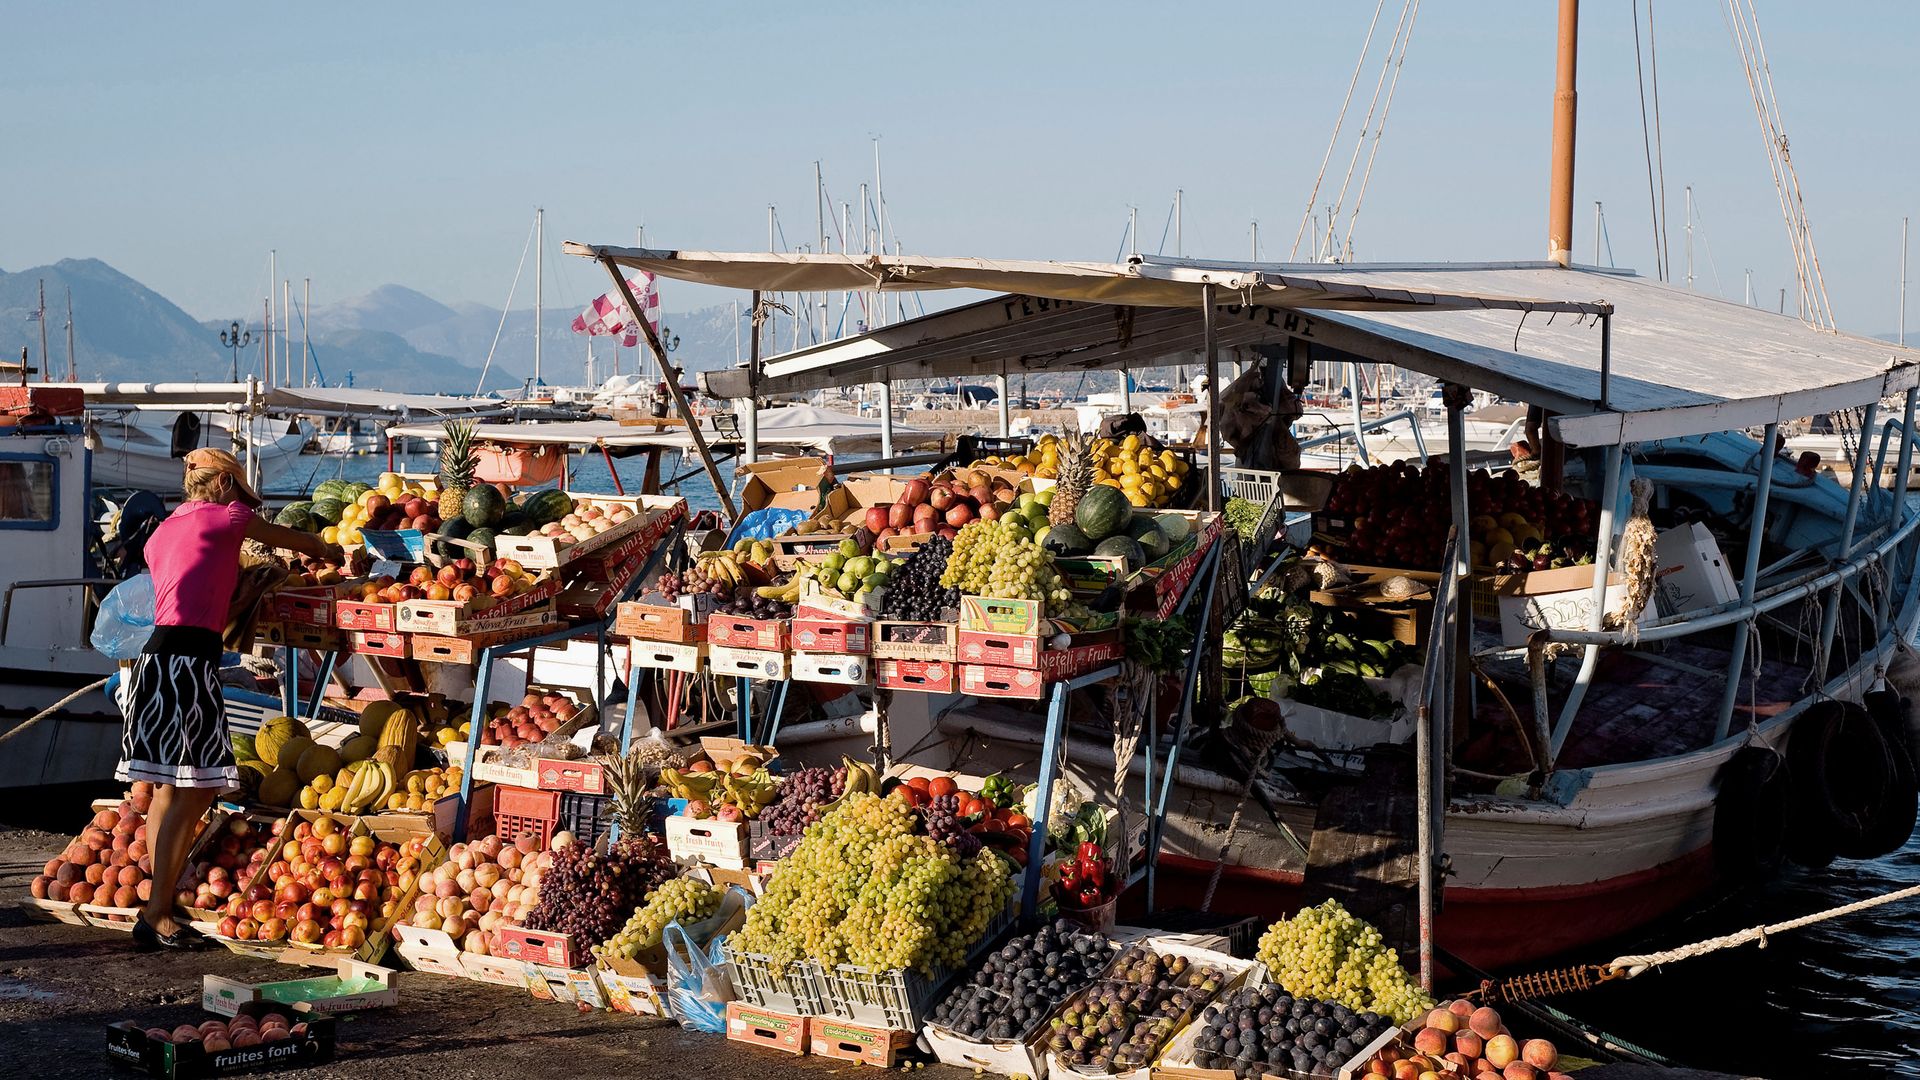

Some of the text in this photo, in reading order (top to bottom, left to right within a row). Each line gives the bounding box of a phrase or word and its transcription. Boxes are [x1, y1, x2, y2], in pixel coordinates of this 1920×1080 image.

[655, 500, 688, 533] Nefeli
[619, 529, 645, 556] Fruit
[1169, 555, 1192, 581] Fruit
[609, 566, 632, 597] Fruit
[523, 587, 548, 607] Fruit
[1040, 646, 1111, 668] Nefeli Fruit
[489, 767, 523, 779] fresh fruits
[685, 835, 724, 849] fresh fruits
[108, 1042, 140, 1059] fruites font
[215, 1051, 263, 1067] fruites
[268, 1044, 297, 1058] font
